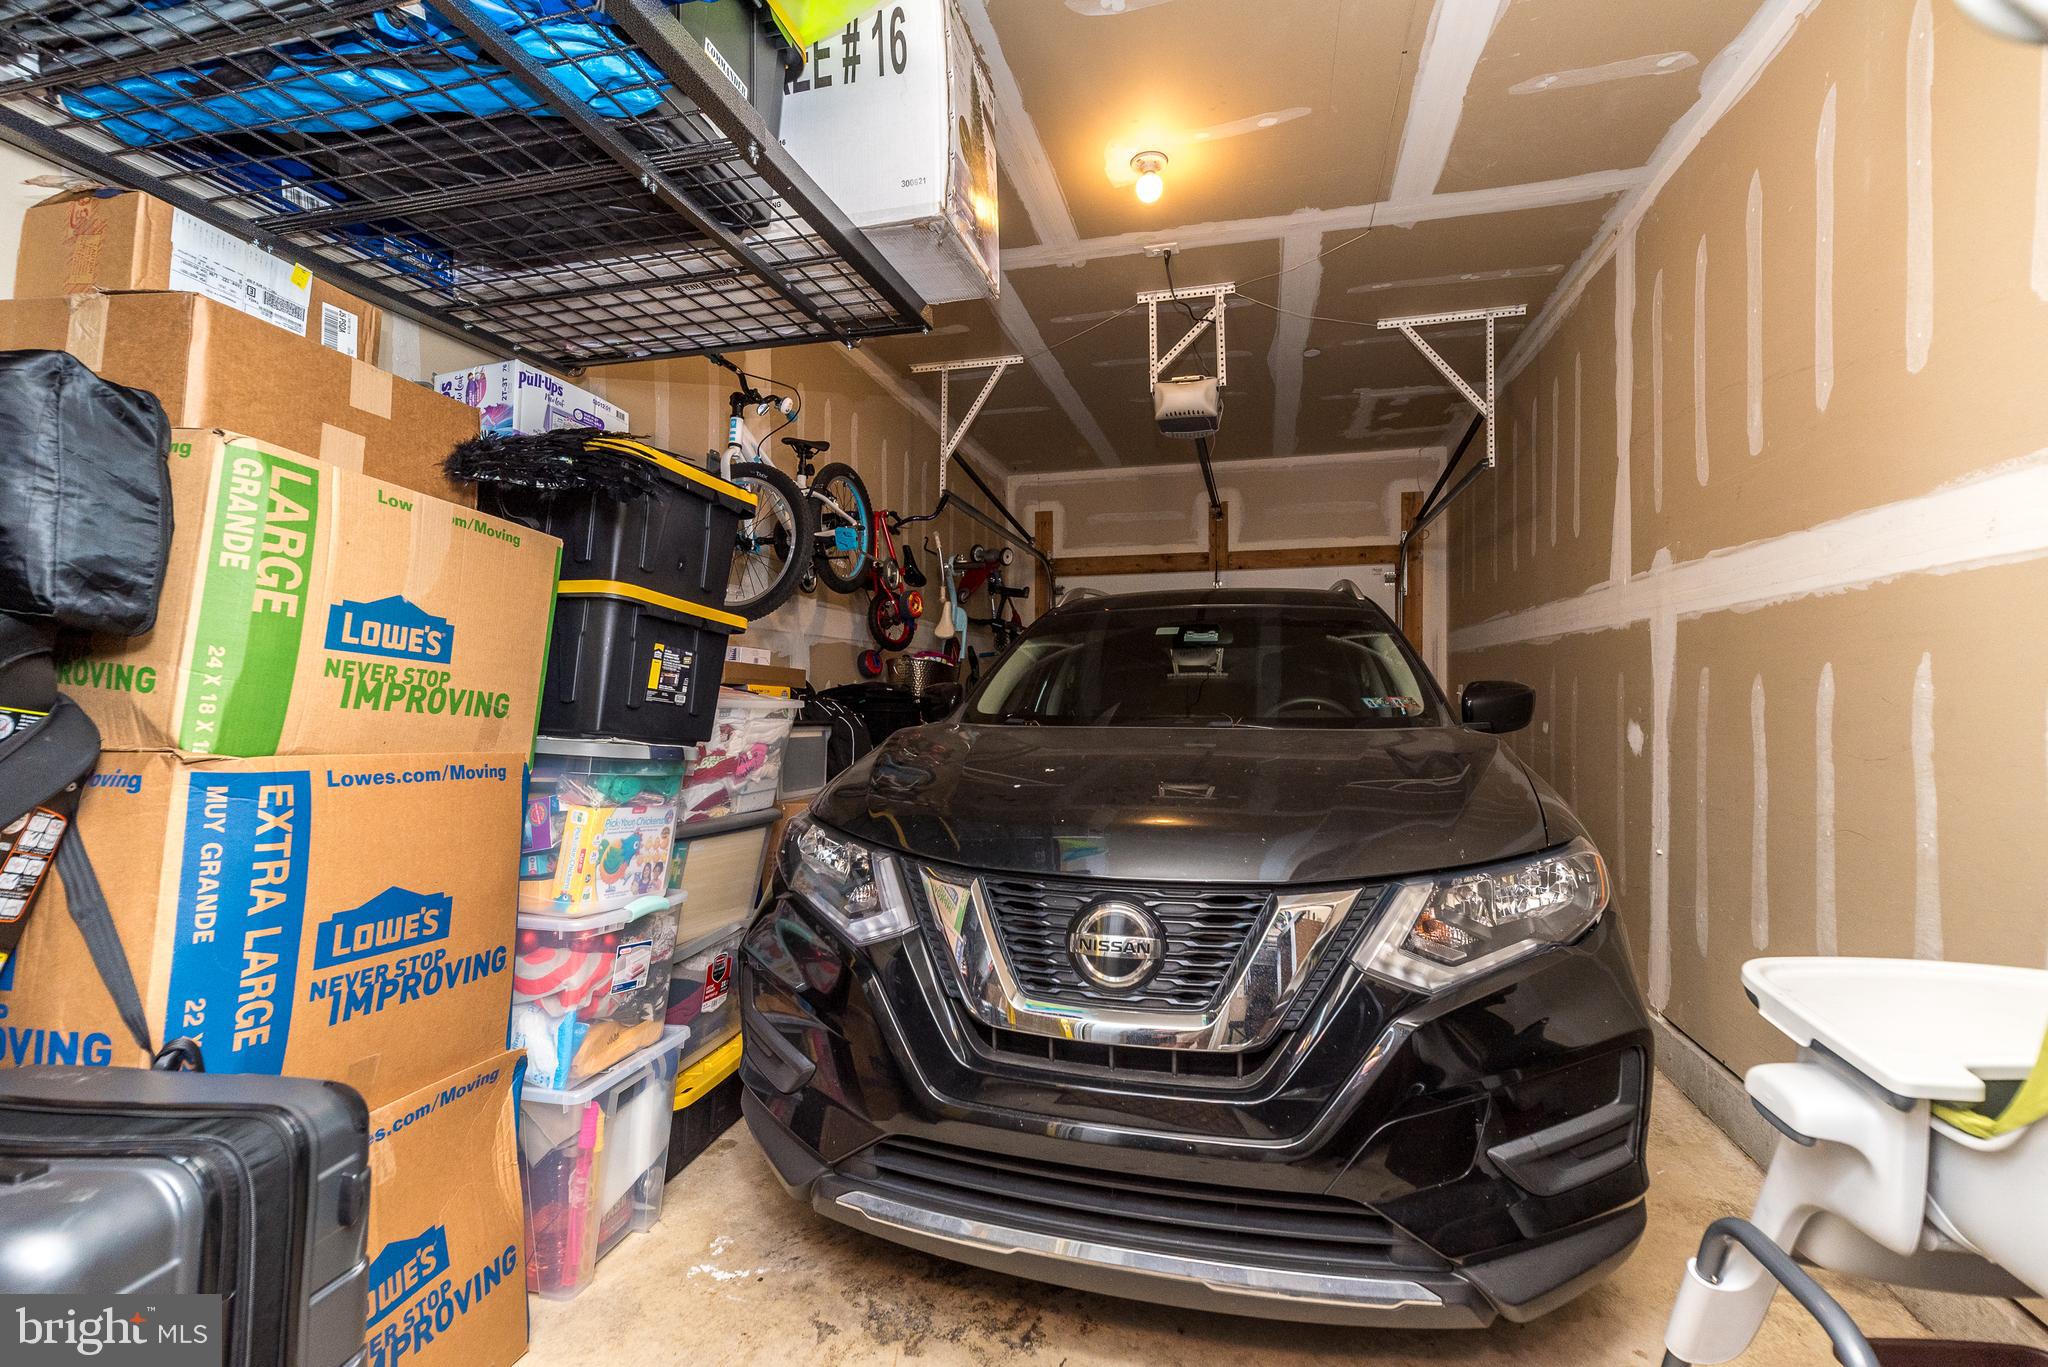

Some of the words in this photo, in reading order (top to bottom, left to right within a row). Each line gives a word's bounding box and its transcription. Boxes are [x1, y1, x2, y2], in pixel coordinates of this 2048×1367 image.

[872, 7, 907, 77] 16
[706, 42, 747, 98] COMMANDER
[518, 371, 563, 397] Pull-Ups
[219, 457, 264, 571] GRANDE
[252, 464, 311, 618] LARGE
[206, 644, 226, 668] 24
[341, 611, 442, 657] LOWE'S
[324, 658, 399, 685] NEVER
[401, 667, 452, 688] STOP
[340, 675, 511, 719] IMPROVING
[198, 693, 218, 714] 18
[326, 764, 507, 788] Lowes.com/Moving
[203, 785, 229, 833] MUY
[247, 784, 295, 917] EXTRA
[192, 842, 223, 945] GRANDE
[331, 905, 441, 957] LOWE'S
[1080, 938, 1151, 954] NISSAN
[232, 926, 282, 1053] LARGE
[309, 963, 390, 1003] NEVER
[393, 948, 447, 979] STOP
[328, 945, 508, 1028] IMPROVING
[183, 998, 207, 1028] 22
[403, 1278, 452, 1333] STOP
